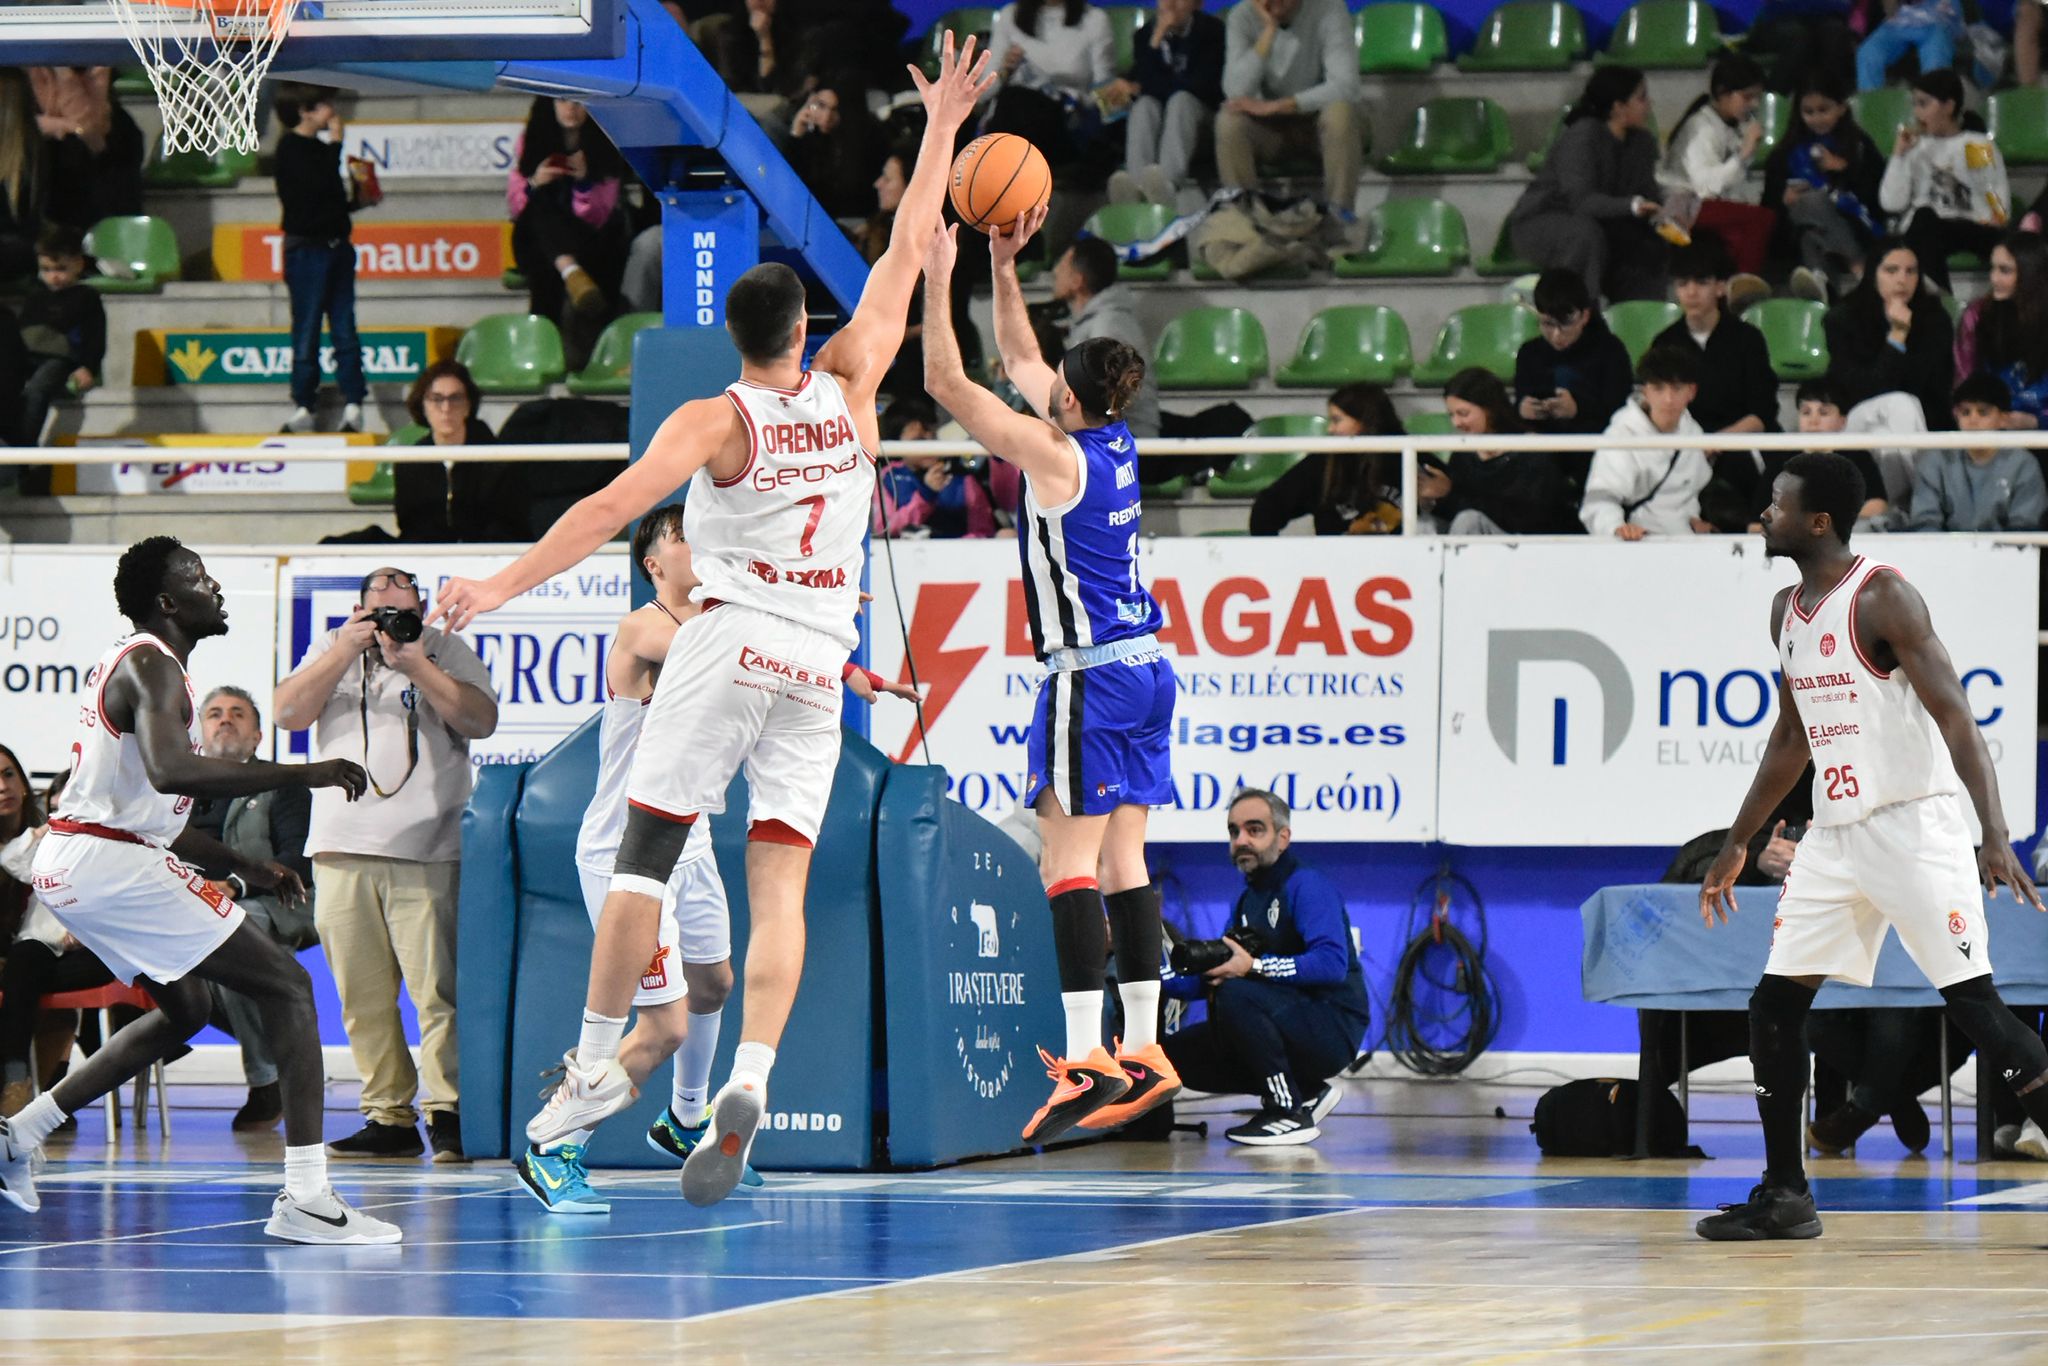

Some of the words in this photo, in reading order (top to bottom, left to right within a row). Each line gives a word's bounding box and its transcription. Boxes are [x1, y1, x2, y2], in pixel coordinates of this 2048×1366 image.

[693, 231, 716, 326] MONDO
[762, 414, 854, 454] ORENGA
[793, 494, 826, 557] 7
[1231, 666, 1404, 696] ELÉCTRICAS
[1795, 676, 1816, 690] CAJA
[1816, 672, 1855, 688] RURAL
[1657, 740, 1689, 765] EL
[1824, 765, 1860, 801] 25
[642, 975, 664, 988] HAM
